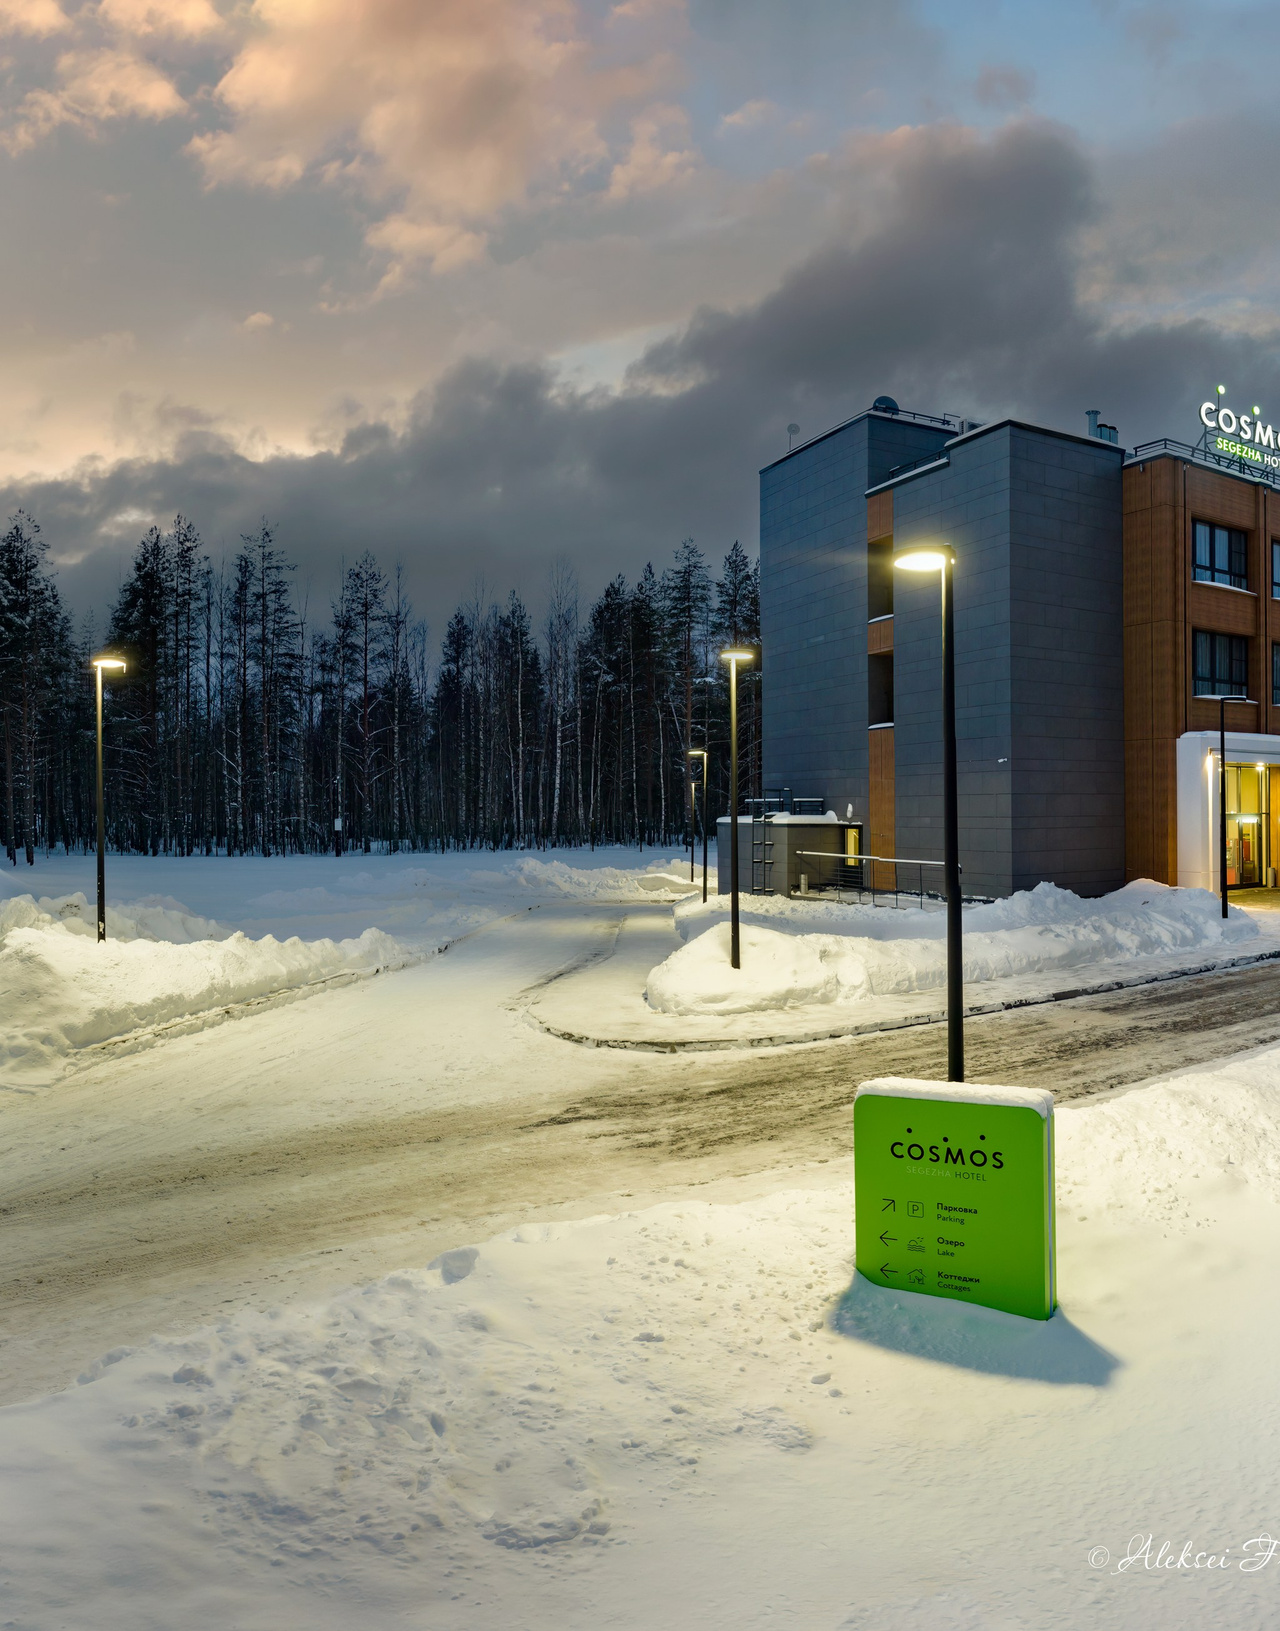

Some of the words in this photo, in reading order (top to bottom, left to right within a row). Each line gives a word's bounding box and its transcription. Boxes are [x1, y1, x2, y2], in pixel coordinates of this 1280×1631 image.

[1216, 437, 1262, 462] SEGEZHA
[891, 1141, 1004, 1169] COSMOS
[906, 1166, 951, 1178] SEGEZHA
[955, 1172, 987, 1182] HOTEL
[936, 1202, 978, 1215] Парковка
[936, 1213, 965, 1225] Parking
[937, 1236, 965, 1248] Озеро
[937, 1248, 955, 1257] Lake
[937, 1271, 980, 1284] Коттеджи
[937, 1281, 971, 1292] Cottages
